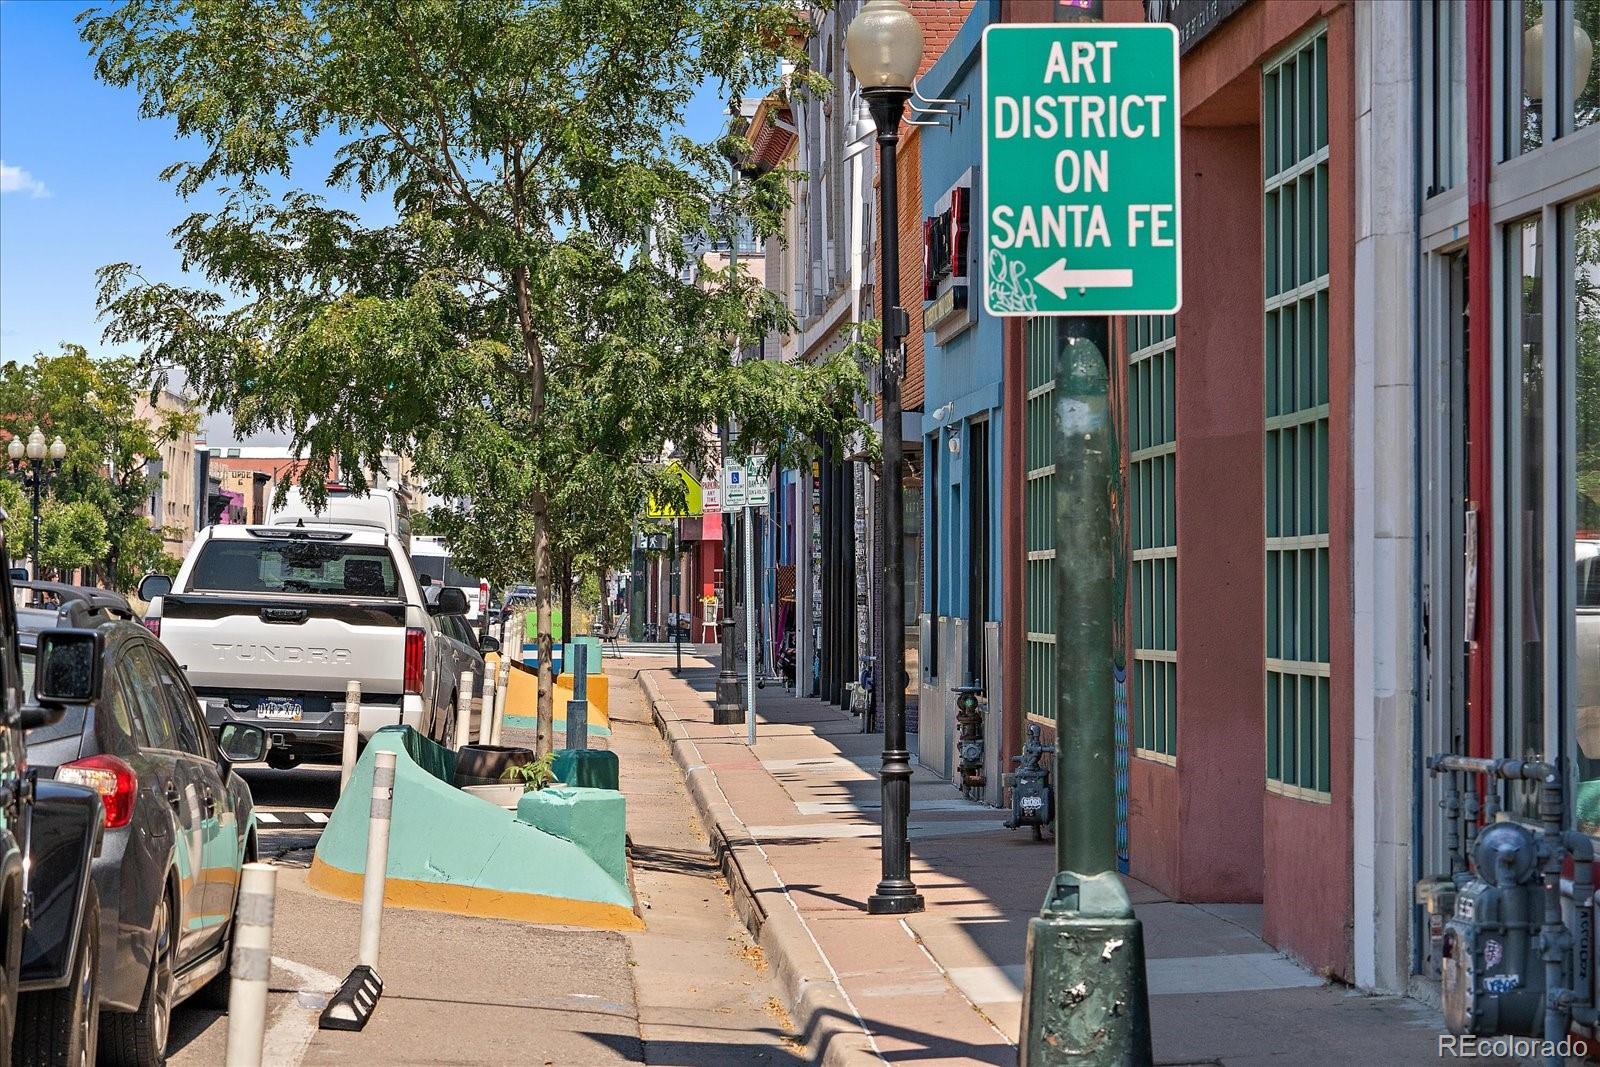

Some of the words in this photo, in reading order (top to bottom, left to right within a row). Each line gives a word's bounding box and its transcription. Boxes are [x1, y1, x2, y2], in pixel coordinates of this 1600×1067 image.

[1043, 41, 1118, 84] ART
[994, 95, 1167, 139] DISTRICT
[1055, 149, 1109, 194] ON
[991, 204, 1111, 250] SANTA
[1128, 204, 1174, 248] FE
[211, 643, 352, 665] TUNDRA
